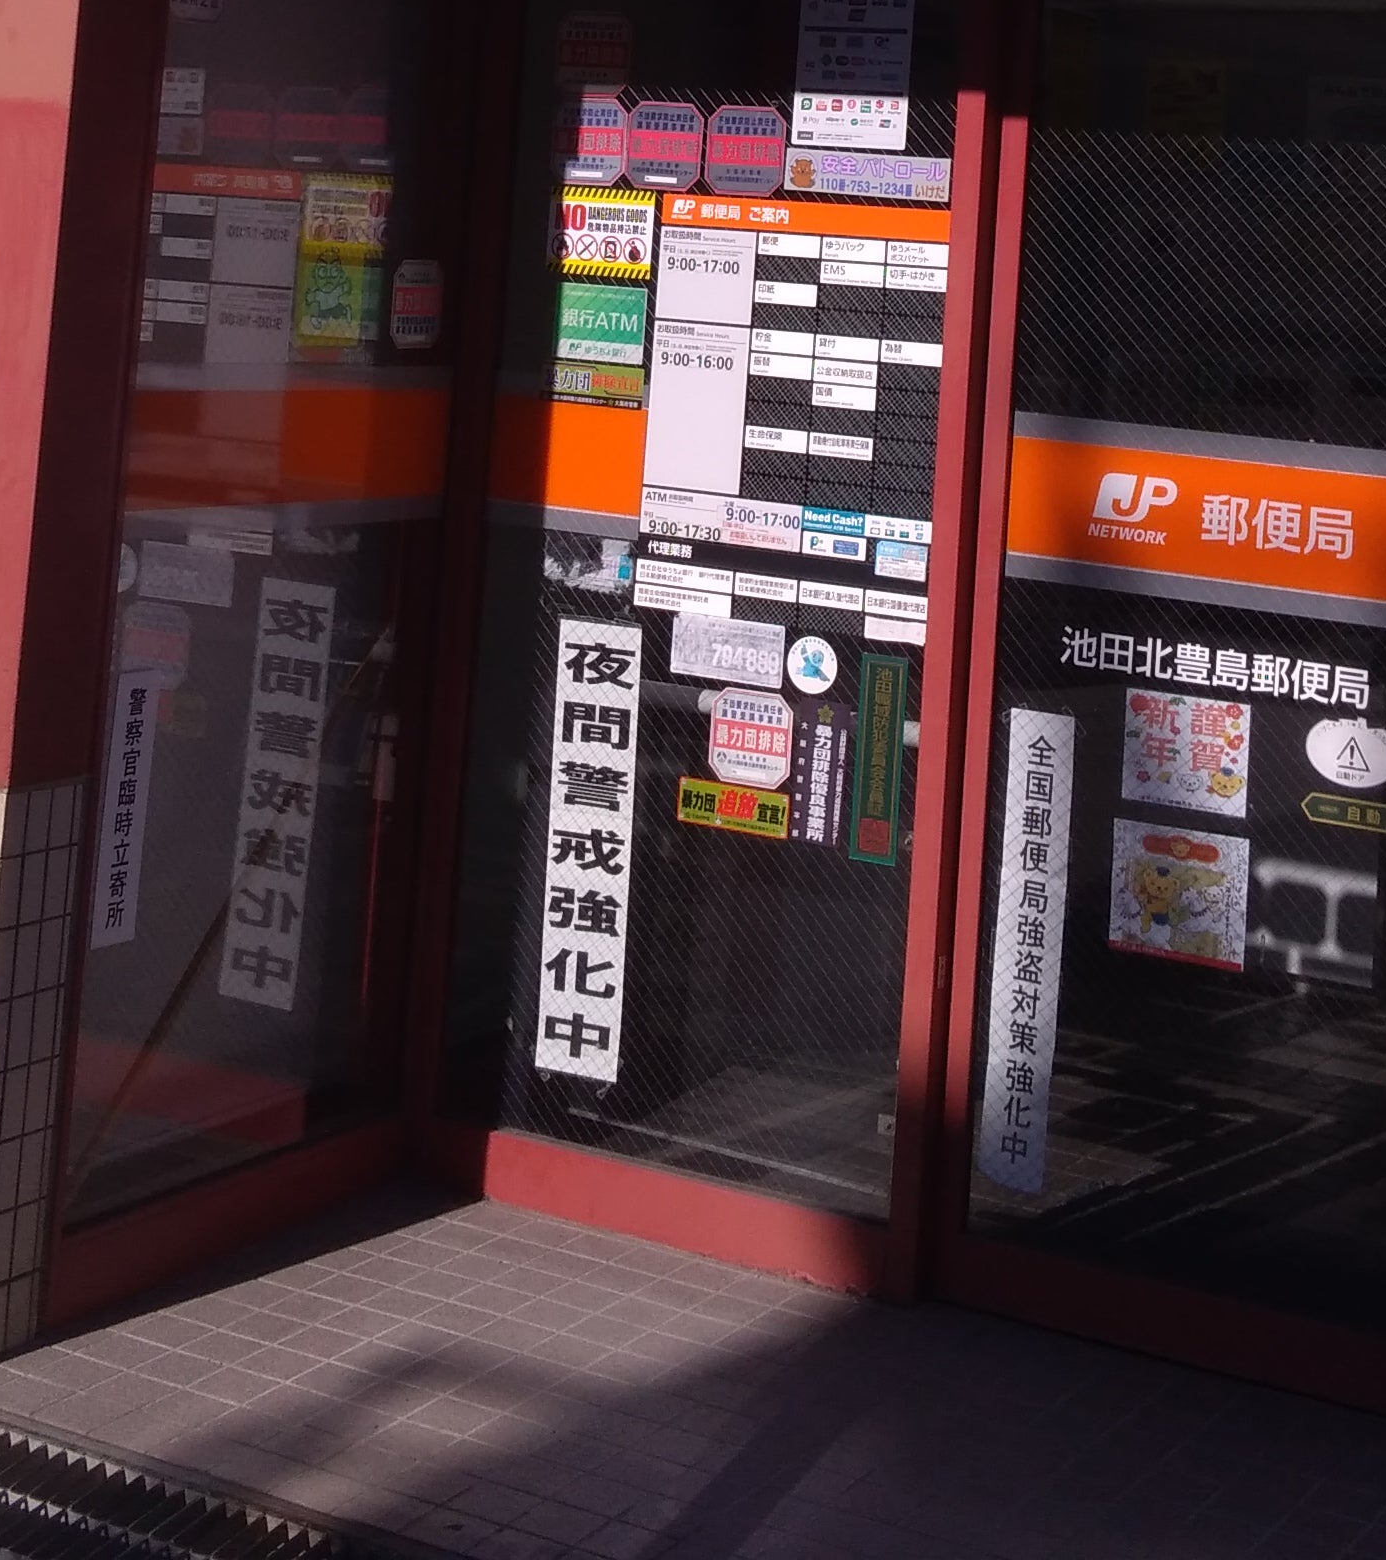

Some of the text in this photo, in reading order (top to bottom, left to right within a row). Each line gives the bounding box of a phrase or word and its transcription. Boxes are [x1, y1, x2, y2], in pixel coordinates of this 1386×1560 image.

[821, 154, 947, 182] 安全パトロール
[914, 184, 945, 200] いけだ
[554, 203, 648, 232] NO DANGEROUS GOODS
[671, 198, 790, 225] JP 郵便局 ご案内
[663, 244, 677, 254] 平日
[761, 235, 780, 247] 郵便
[825, 240, 865, 252] ゆうパック
[890, 243, 926, 255] ゆうメール
[667, 256, 740, 275] 9:00-17:00
[823, 263, 846, 276] EMS
[758, 283, 775, 295] 印紙
[562, 307, 638, 333] 銀行ATM
[656, 339, 670, 348] 平日
[755, 331, 772, 343] 貯金
[819, 337, 836, 349] 貸付
[584, 345, 627, 358] ゆうちょ銀行
[884, 343, 903, 354] 為替
[660, 351, 734, 371] 9:00-16:00
[753, 356, 771, 367] 振替
[816, 366, 873, 381] 公金収納取扱店
[815, 386, 833, 398] 国債
[748, 428, 783, 441] 生命保険
[644, 491, 668, 503] ATM
[725, 506, 801, 530] 9:00-17:00
[804, 509, 864, 527] Need Cash?
[1092, 471, 1355, 561] JP 郵便局
[648, 519, 722, 542] 9:00-17:30
[1087, 522, 1168, 546] NETWORK
[647, 540, 693, 559] 代理業務
[1059, 624, 1371, 710] 池田北豊島郵便局
[715, 723, 786, 755] 暴力団排除
[1140, 694, 1180, 767] 新年
[1189, 702, 1227, 772] 謹賀
[805, 724, 834, 844] 暴力団排除優良事業所
[104, 685, 149, 931] 警察官臨時立寄所
[1346, 806, 1381, 826] 自動
[543, 641, 637, 1059] 夜間警戒強化中
[1000, 733, 1058, 1165] 全国郵便局強盗対策強化中
